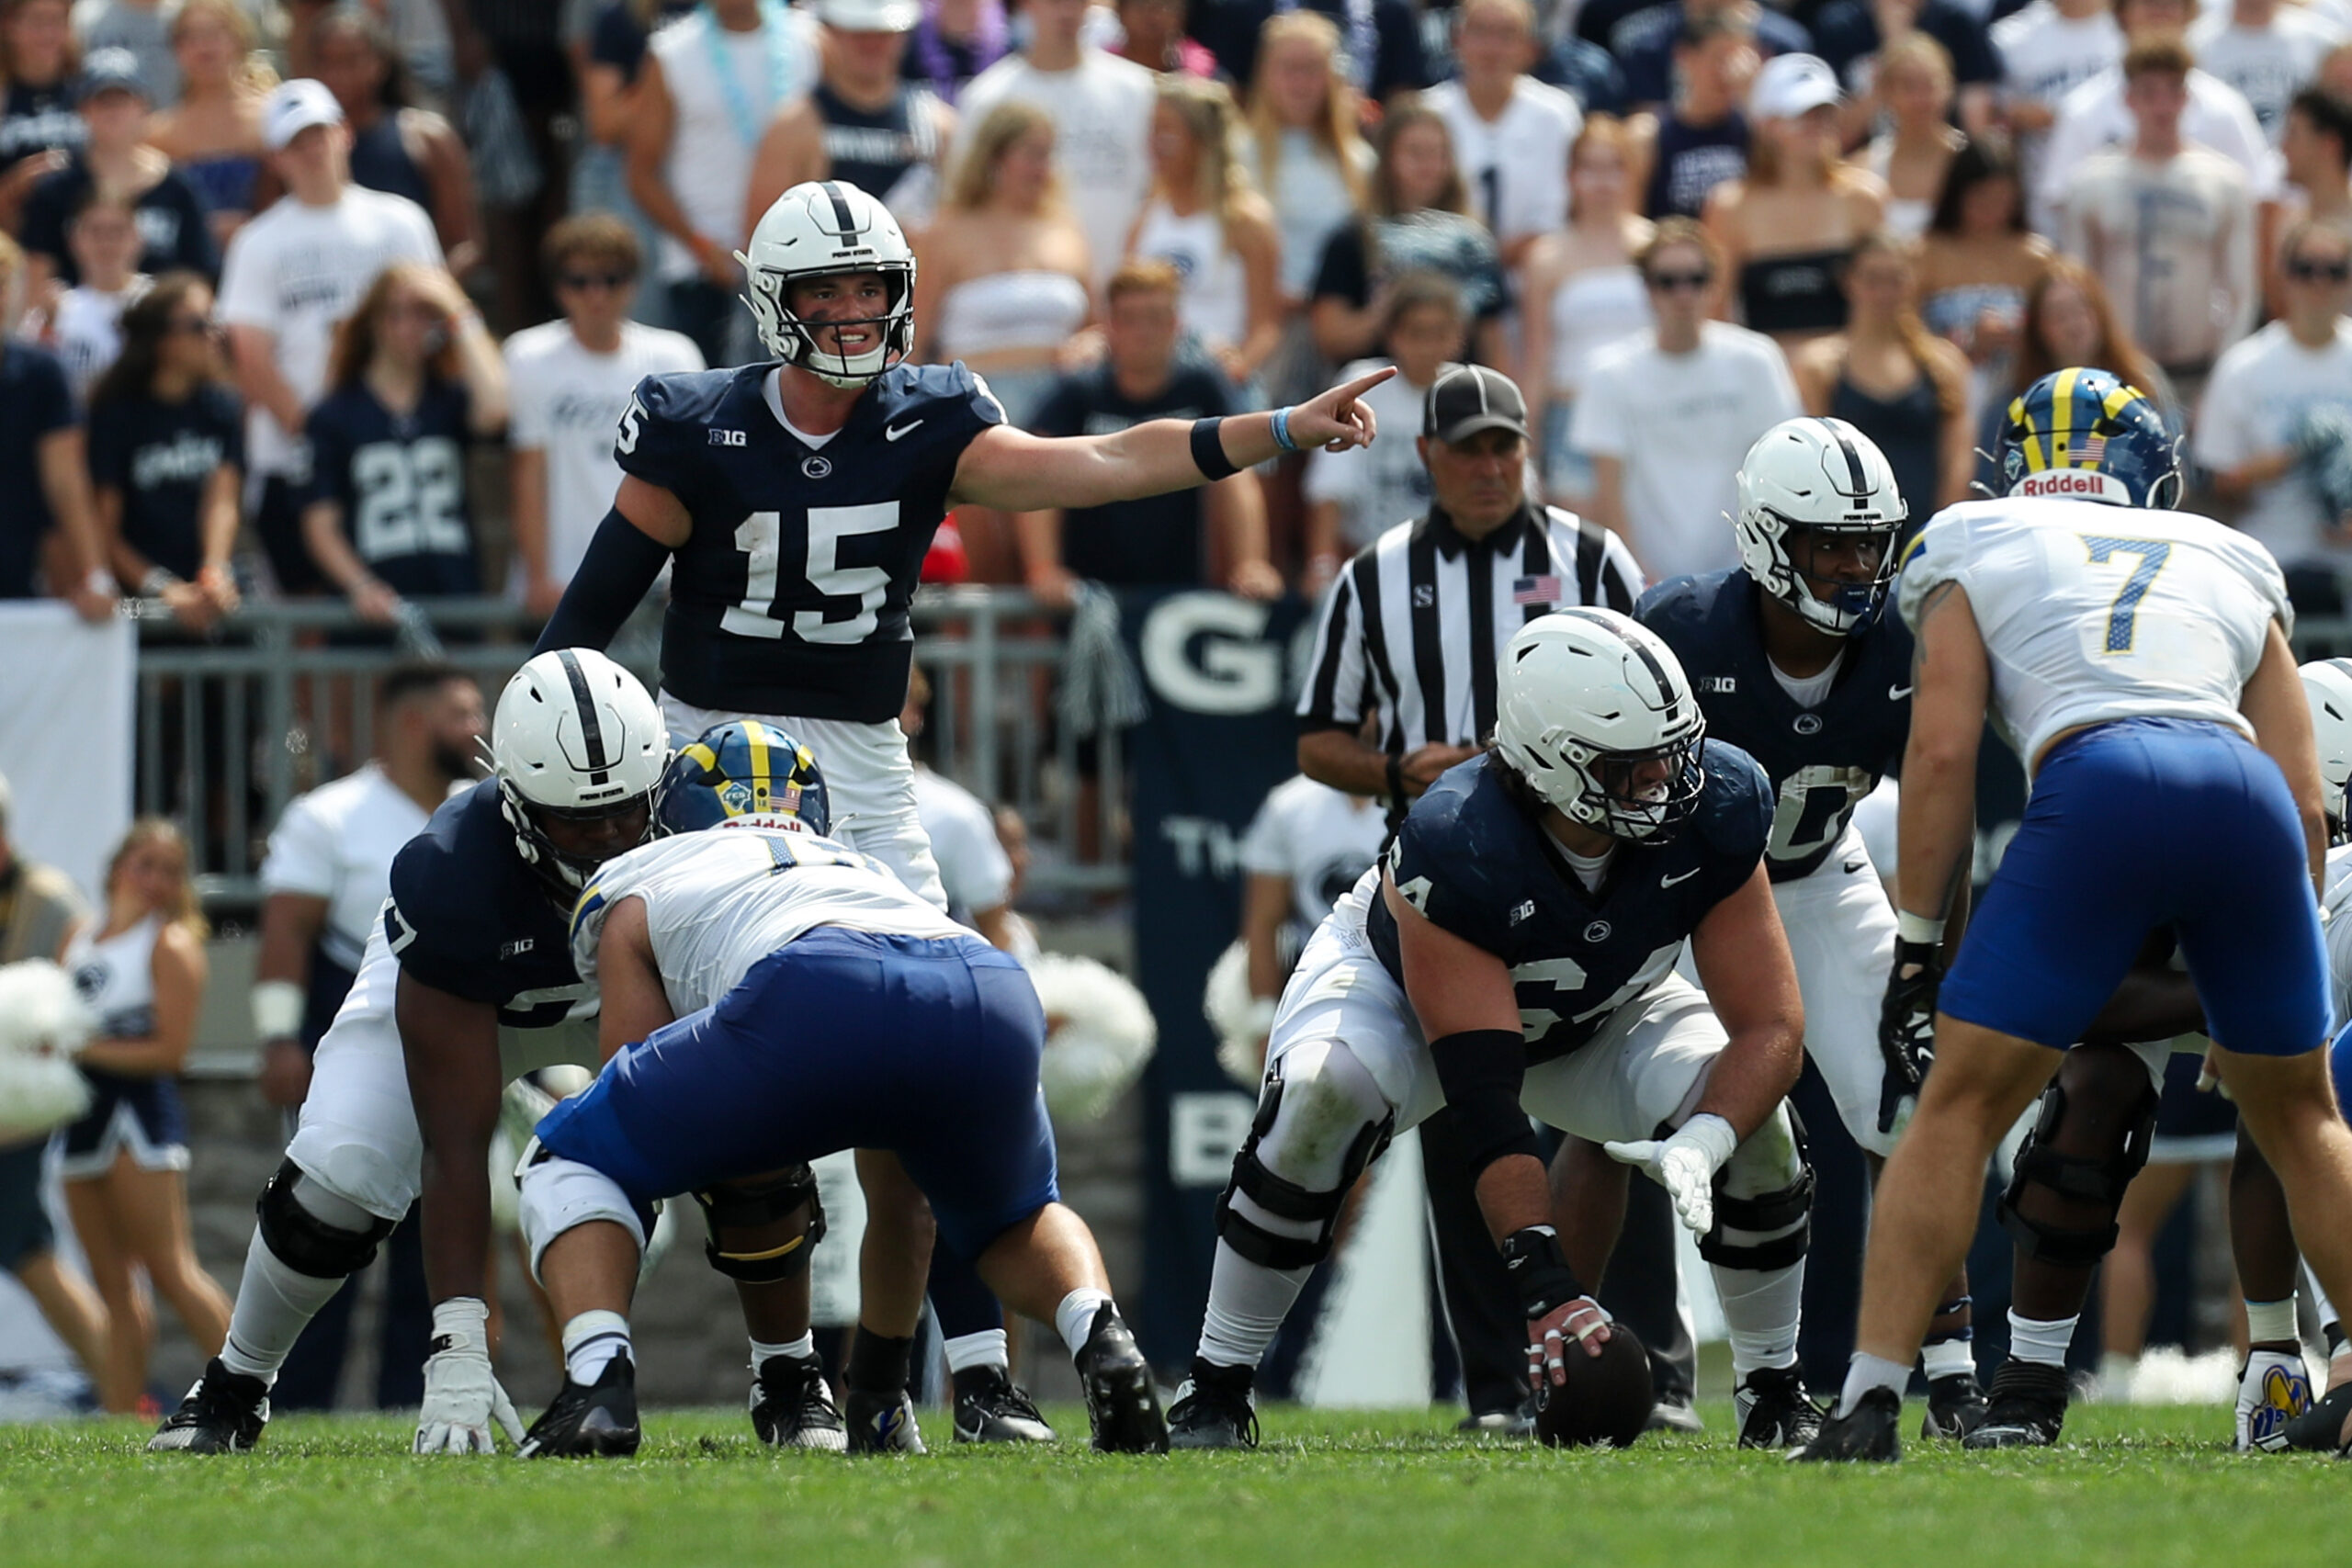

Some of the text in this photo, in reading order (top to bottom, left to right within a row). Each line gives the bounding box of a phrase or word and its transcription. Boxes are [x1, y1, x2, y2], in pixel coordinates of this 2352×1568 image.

[349, 435, 470, 562] 22
[2023, 474, 2104, 497] Riddell
[719, 500, 899, 645] 15
[2075, 533, 2174, 655] 7
